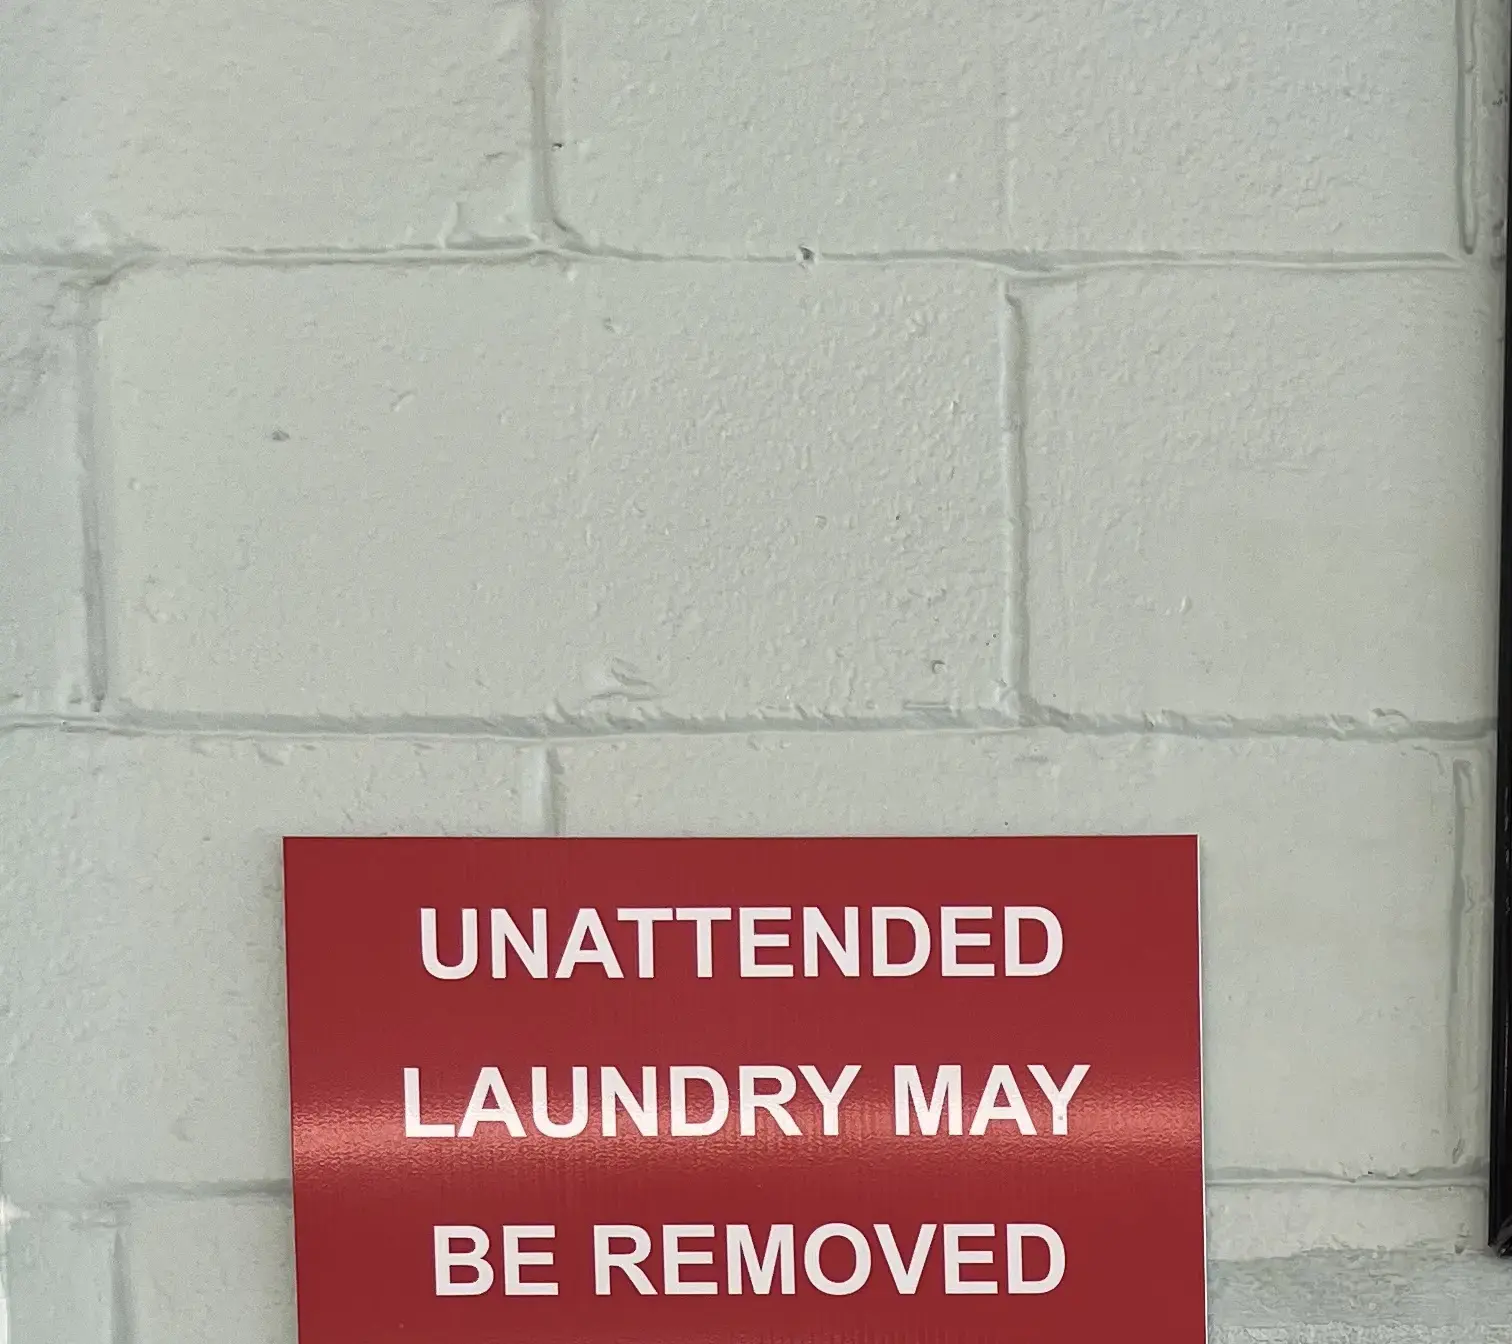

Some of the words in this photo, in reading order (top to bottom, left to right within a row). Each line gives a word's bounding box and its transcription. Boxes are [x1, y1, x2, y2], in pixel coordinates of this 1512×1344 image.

[421, 906, 1063, 979] UNATTENDED
[402, 1065, 861, 1138] LAUNDRY
[894, 1065, 1090, 1135] MAY
[434, 1225, 558, 1295] BE
[594, 1223, 1065, 1295] REMOVED
